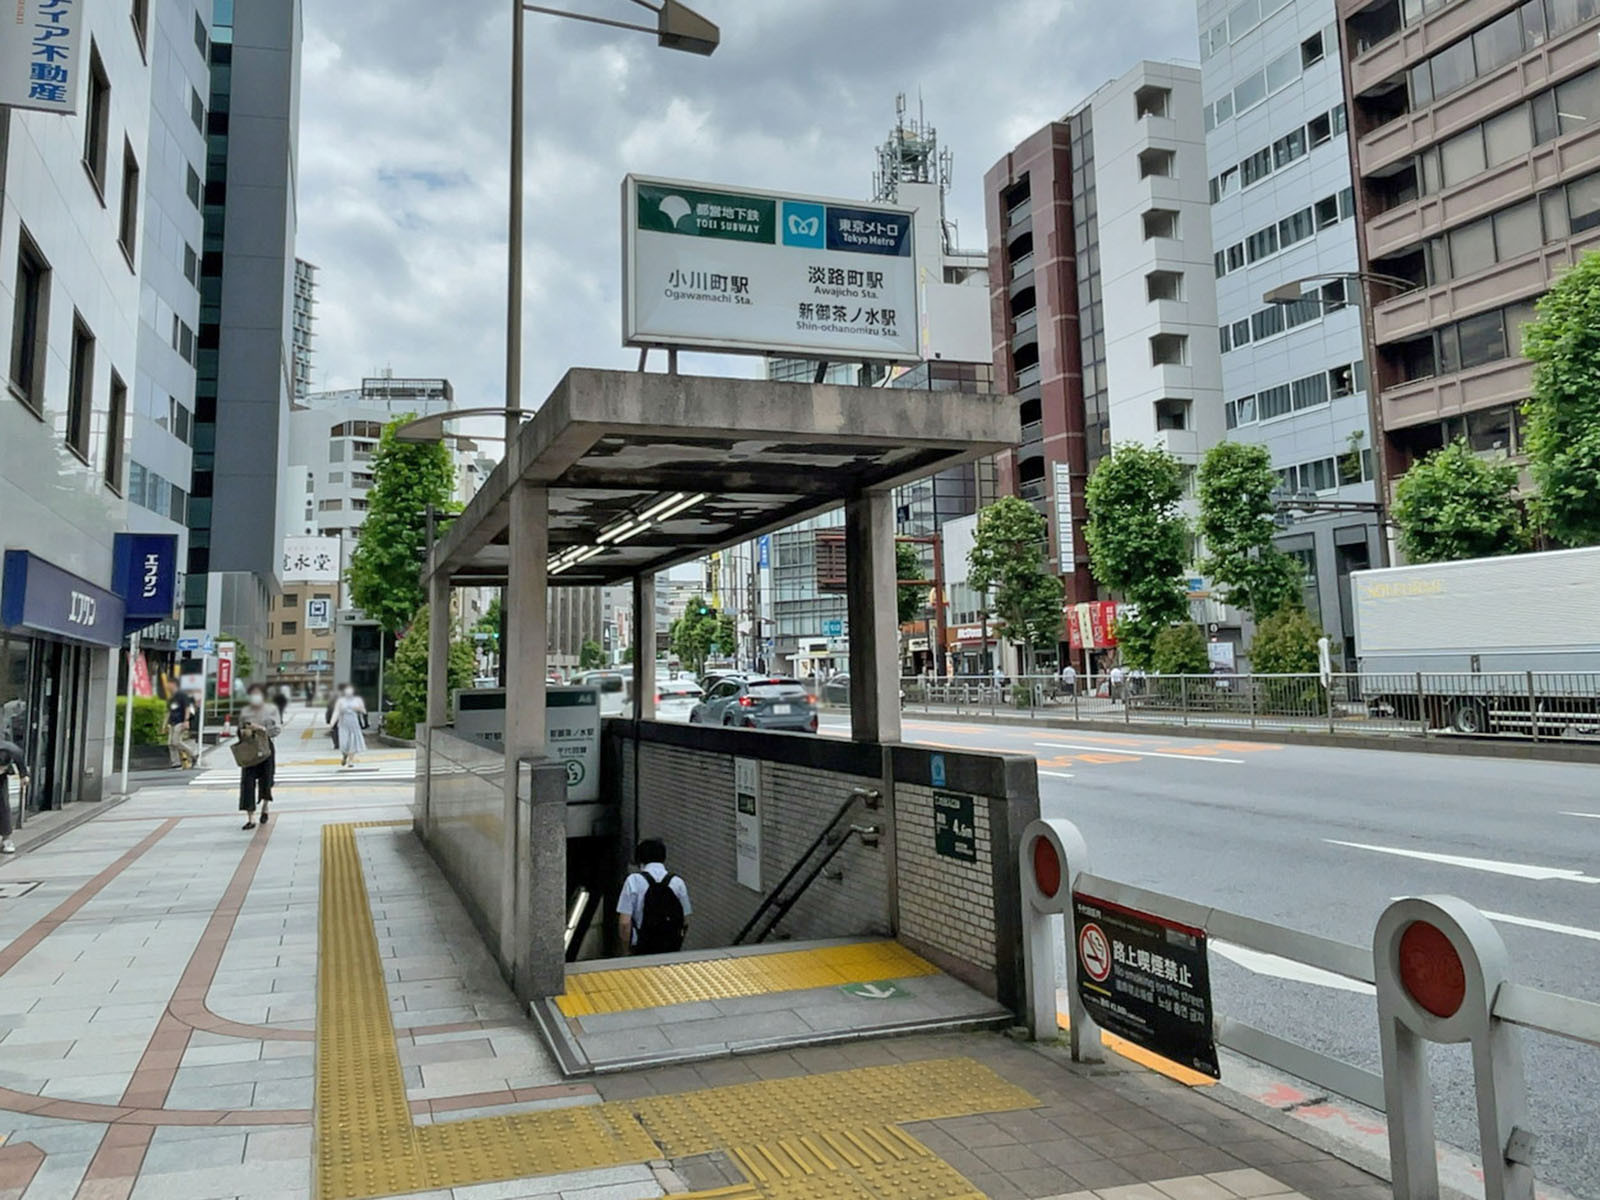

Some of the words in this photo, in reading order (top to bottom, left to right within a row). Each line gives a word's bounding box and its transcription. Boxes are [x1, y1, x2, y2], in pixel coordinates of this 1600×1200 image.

[696, 203, 760, 222] 都営地下鉄
[696, 220, 717, 231] TOEI
[720, 221, 760, 234] SUBWAY
[838, 219, 898, 237] 東京メトロ
[842, 233, 868, 246] Tokyo
[869, 235, 896, 247] Metro
[668, 269, 749, 295] 小川町駅
[808, 265, 884, 290] 淡路町駅
[664, 288, 732, 304] Ogawamachi
[734, 294, 753, 306] Sta.
[814, 285, 859, 299] Awajicho
[860, 287, 879, 299] Sta.
[798, 302, 896, 327] 新御茶ノ水駅
[796, 320, 880, 337] Shin-ochanomizu
[881, 327, 900, 338] Sta.
[1112, 939, 1194, 989] 路上喫煙禁止
